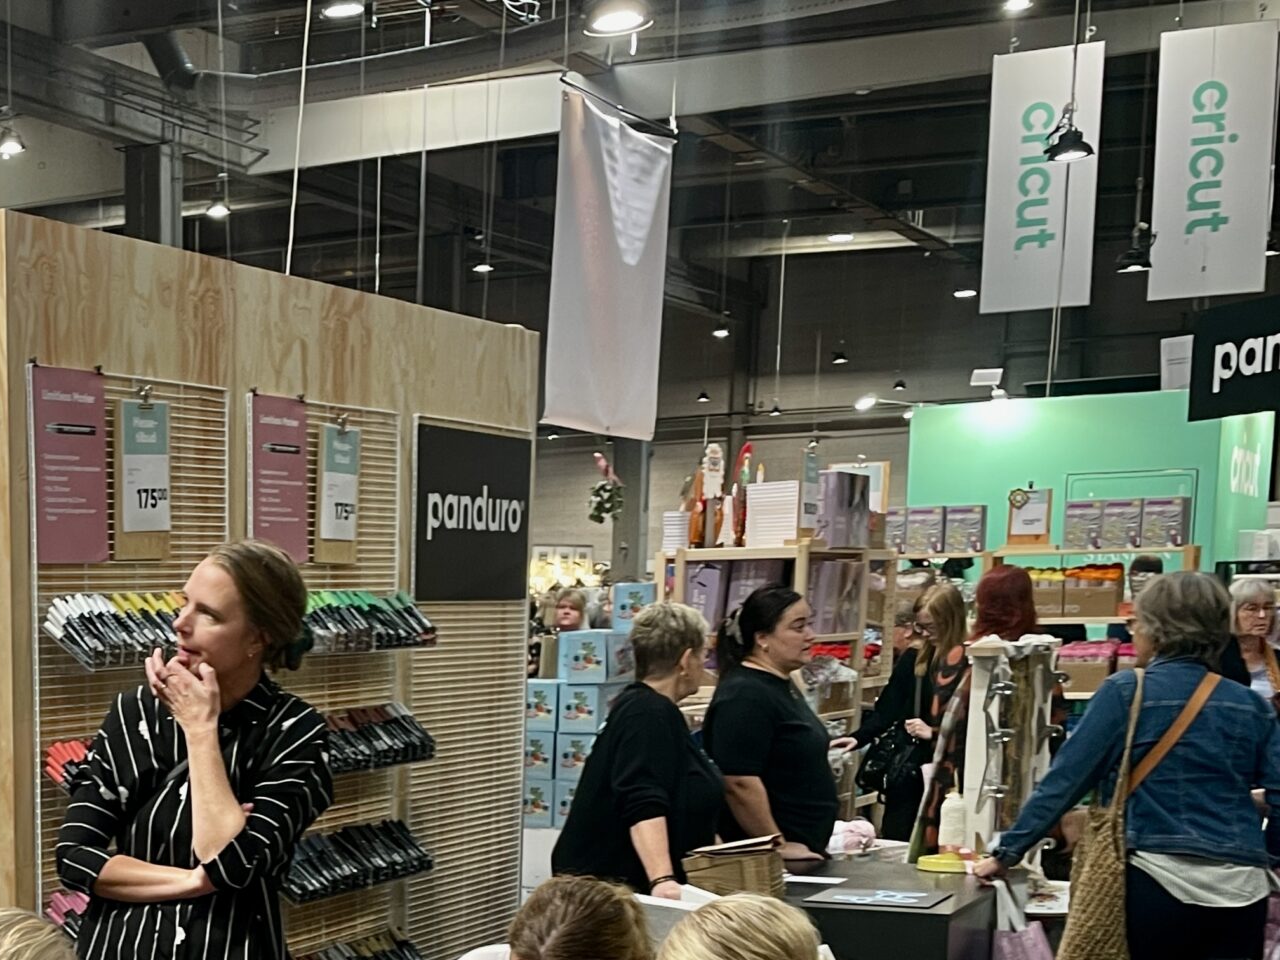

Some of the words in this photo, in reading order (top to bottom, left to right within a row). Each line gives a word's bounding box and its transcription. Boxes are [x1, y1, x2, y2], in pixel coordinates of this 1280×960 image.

[1014, 102, 1056, 251] cricut
[1184, 80, 1239, 235] cricut
[426, 485, 521, 540] panduro
